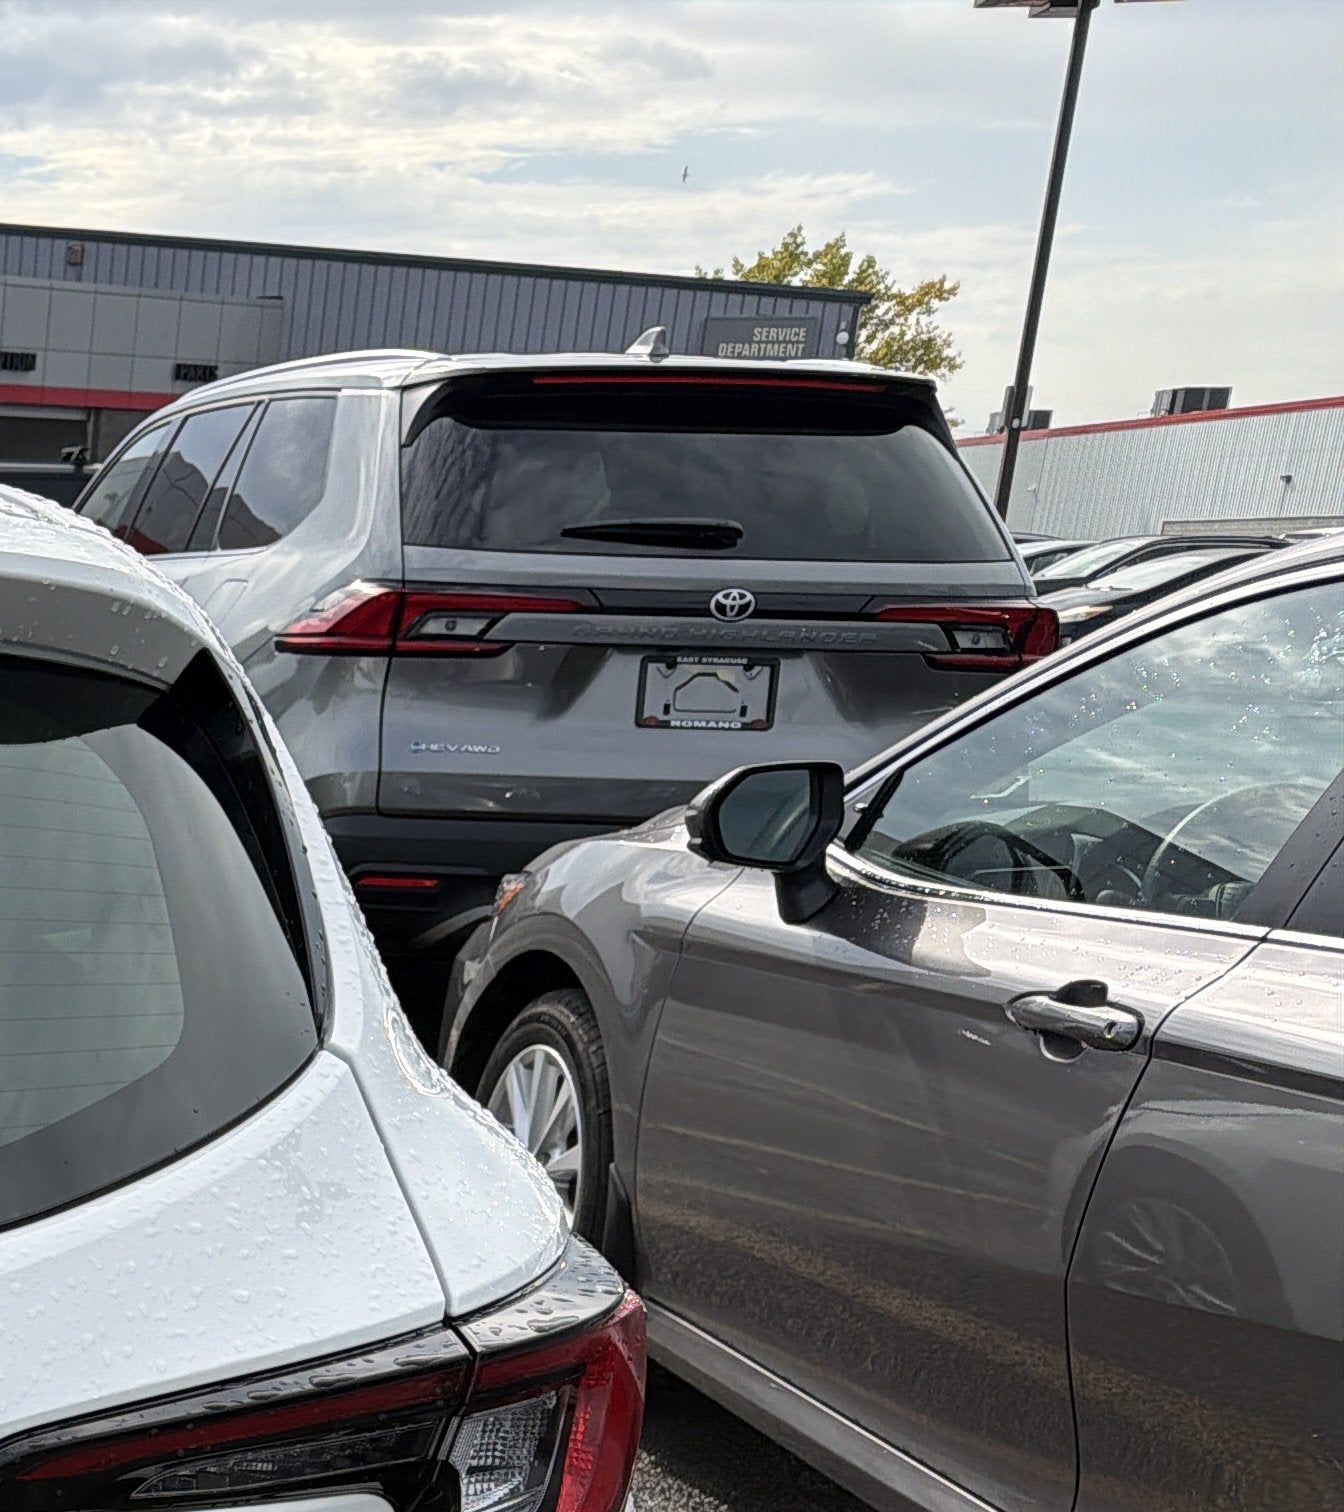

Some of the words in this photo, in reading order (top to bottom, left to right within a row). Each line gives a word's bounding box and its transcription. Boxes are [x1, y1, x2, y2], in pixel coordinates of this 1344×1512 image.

[753, 327, 807, 341] SERVICE
[718, 343, 805, 357] DEPARTMENT
[670, 720, 742, 729] ROMANO
